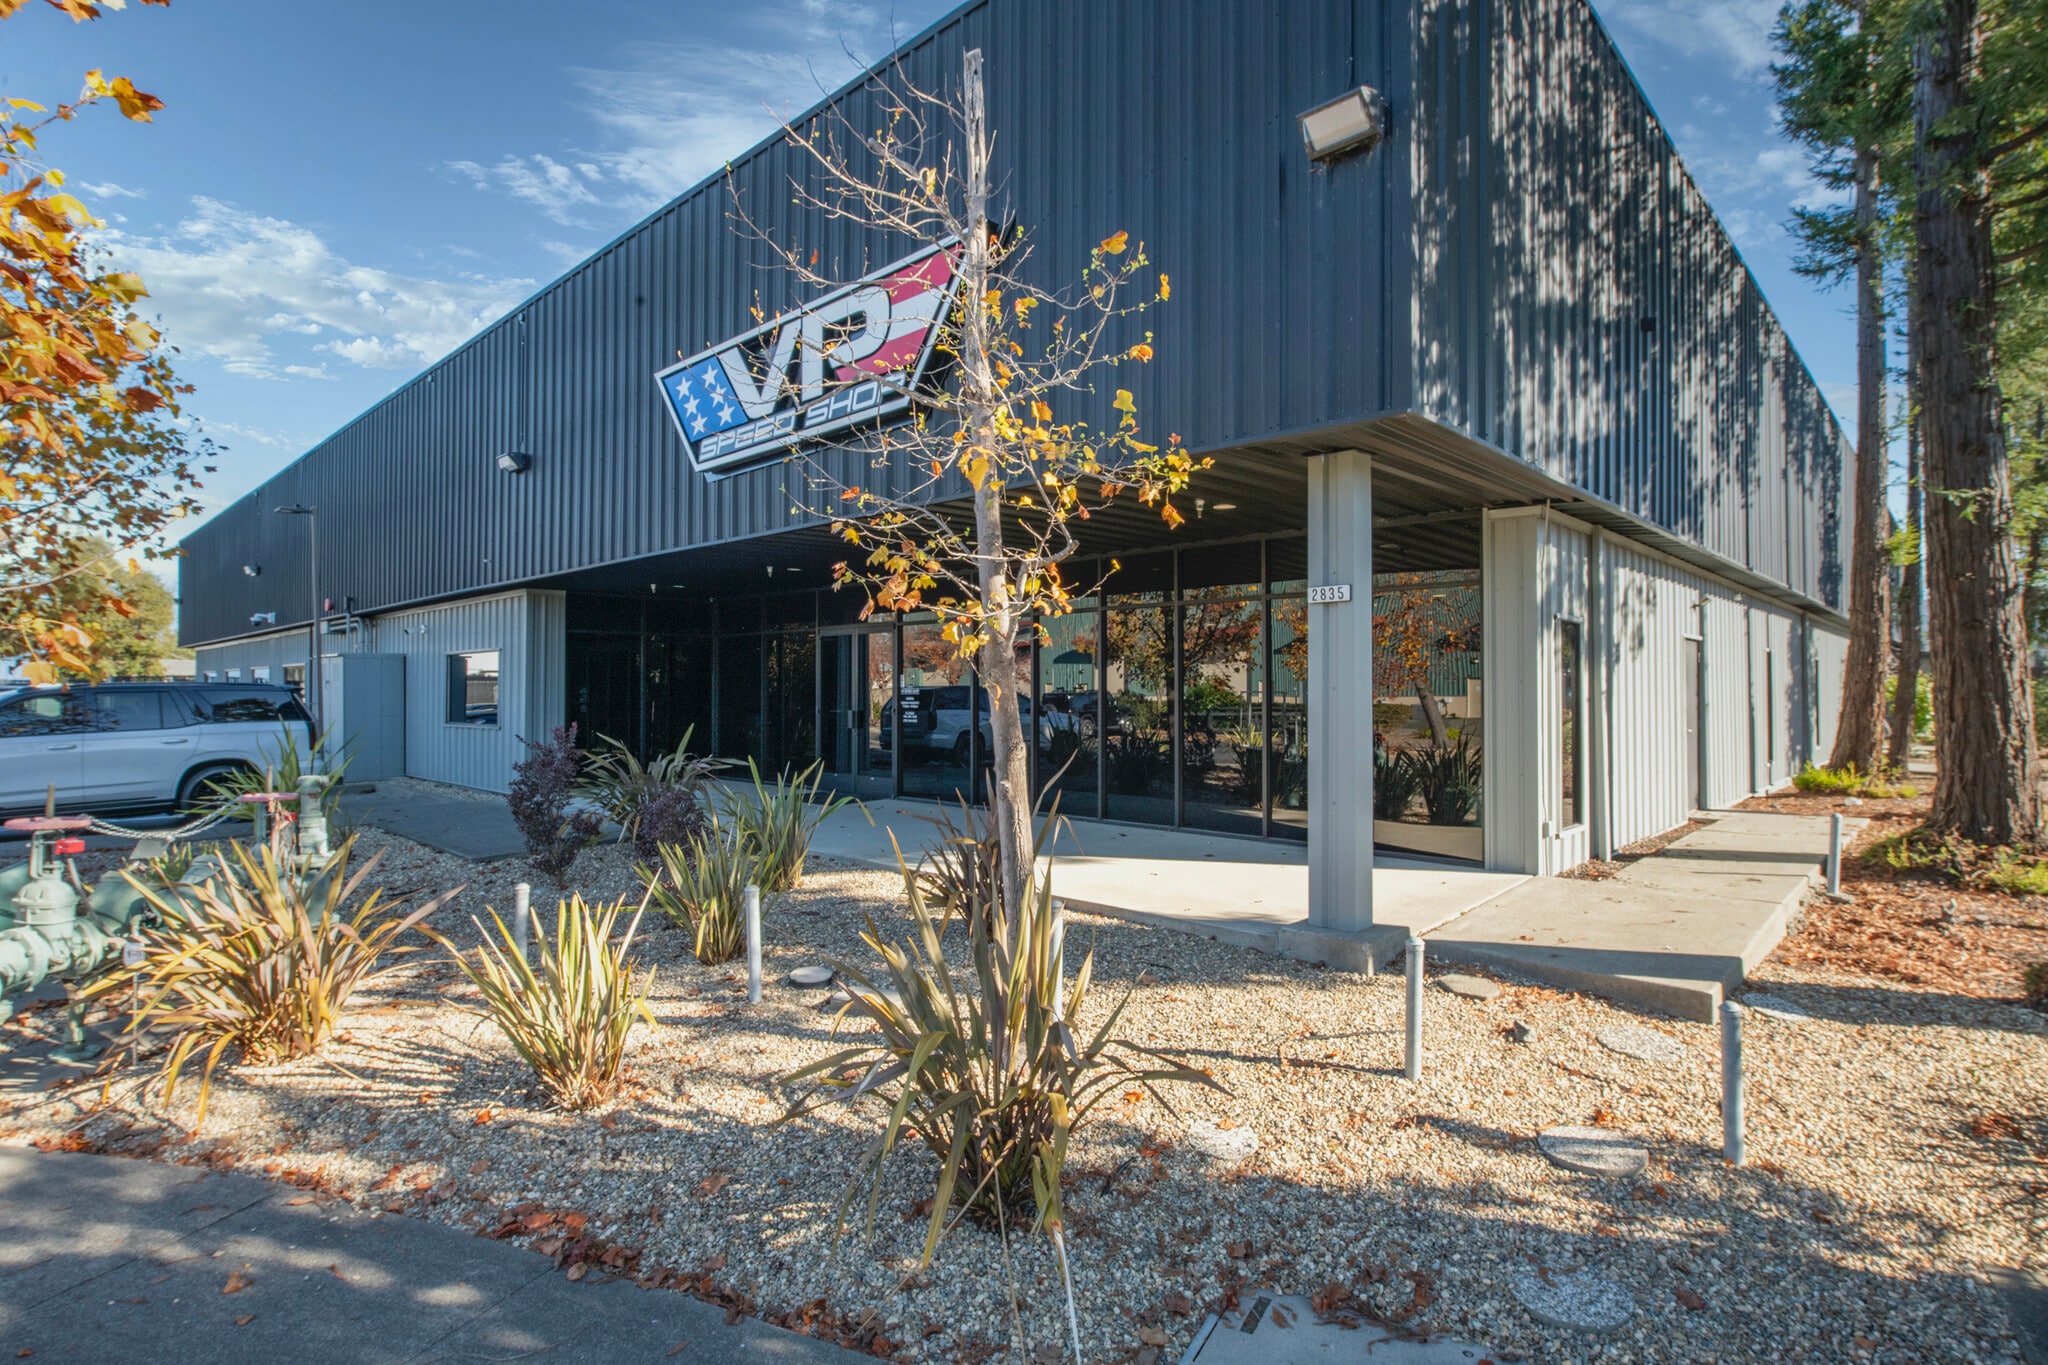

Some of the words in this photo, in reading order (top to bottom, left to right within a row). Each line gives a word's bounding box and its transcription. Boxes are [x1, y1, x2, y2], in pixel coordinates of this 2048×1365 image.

[717, 285, 891, 419] VP
[700, 410, 796, 459] SPEED
[1311, 586, 1344, 601] 2835
